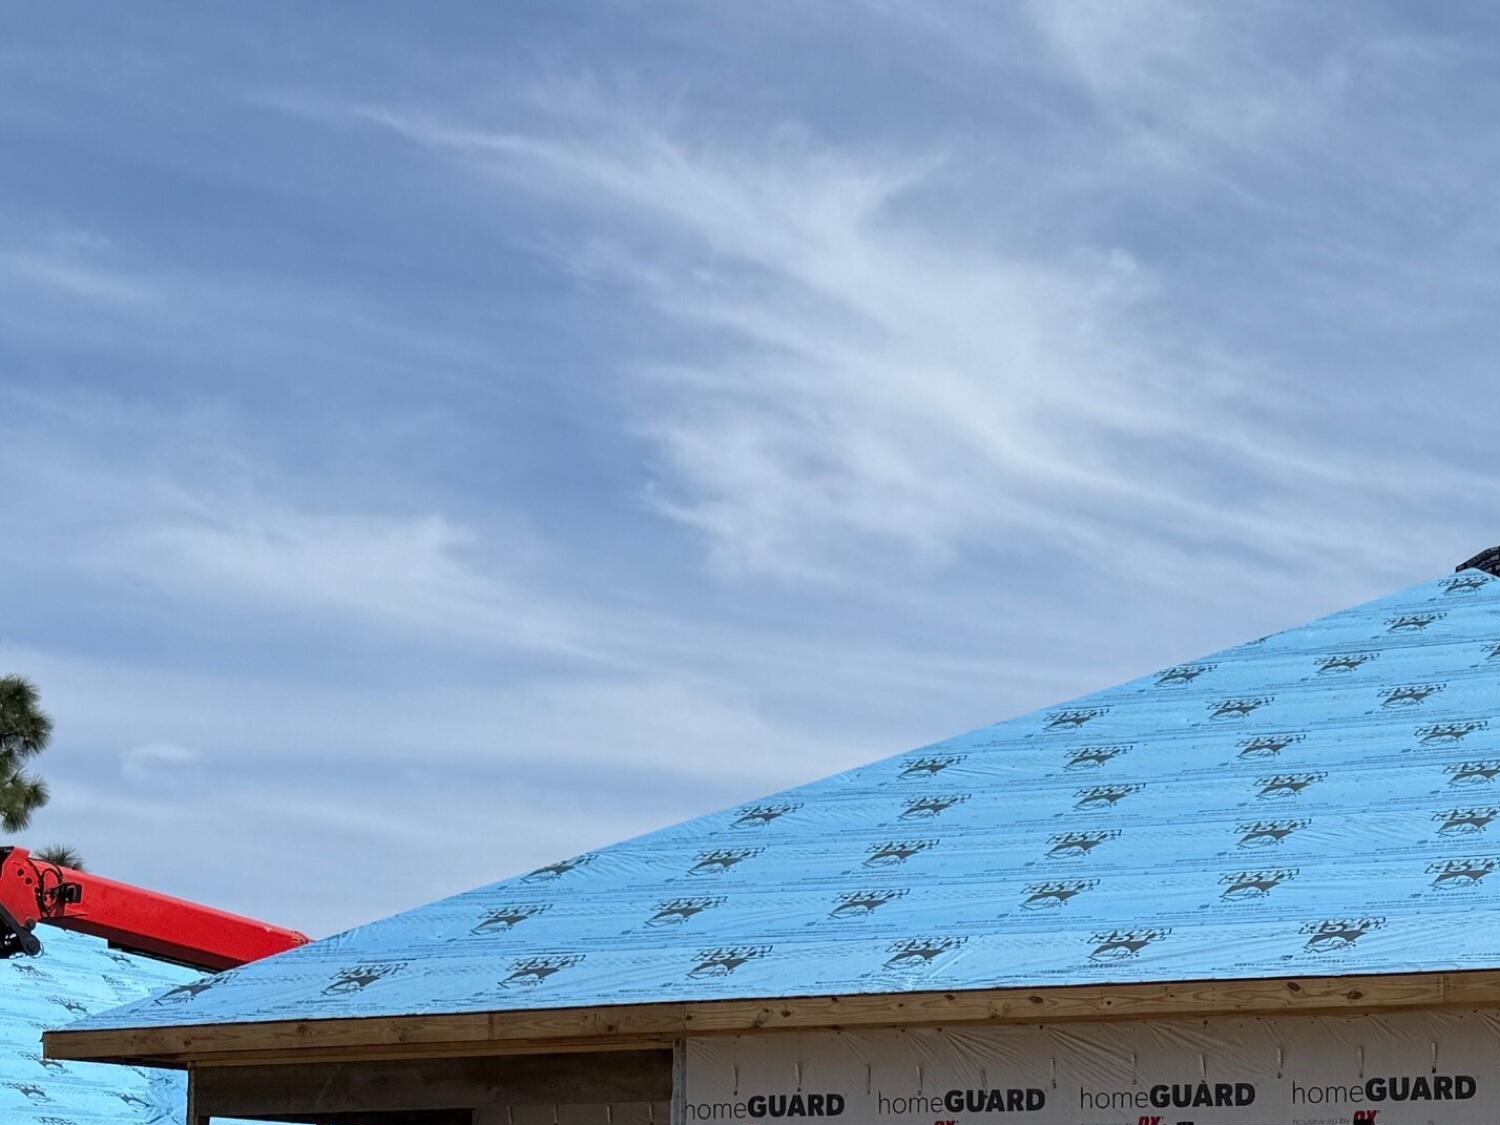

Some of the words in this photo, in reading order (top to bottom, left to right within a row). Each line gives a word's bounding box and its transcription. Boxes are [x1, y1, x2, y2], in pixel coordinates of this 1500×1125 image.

[878, 1088, 1046, 1114] homeGUARD
[1080, 1083, 1256, 1109] homeGUARD
[1292, 1076, 1477, 1104] homeGUARD
